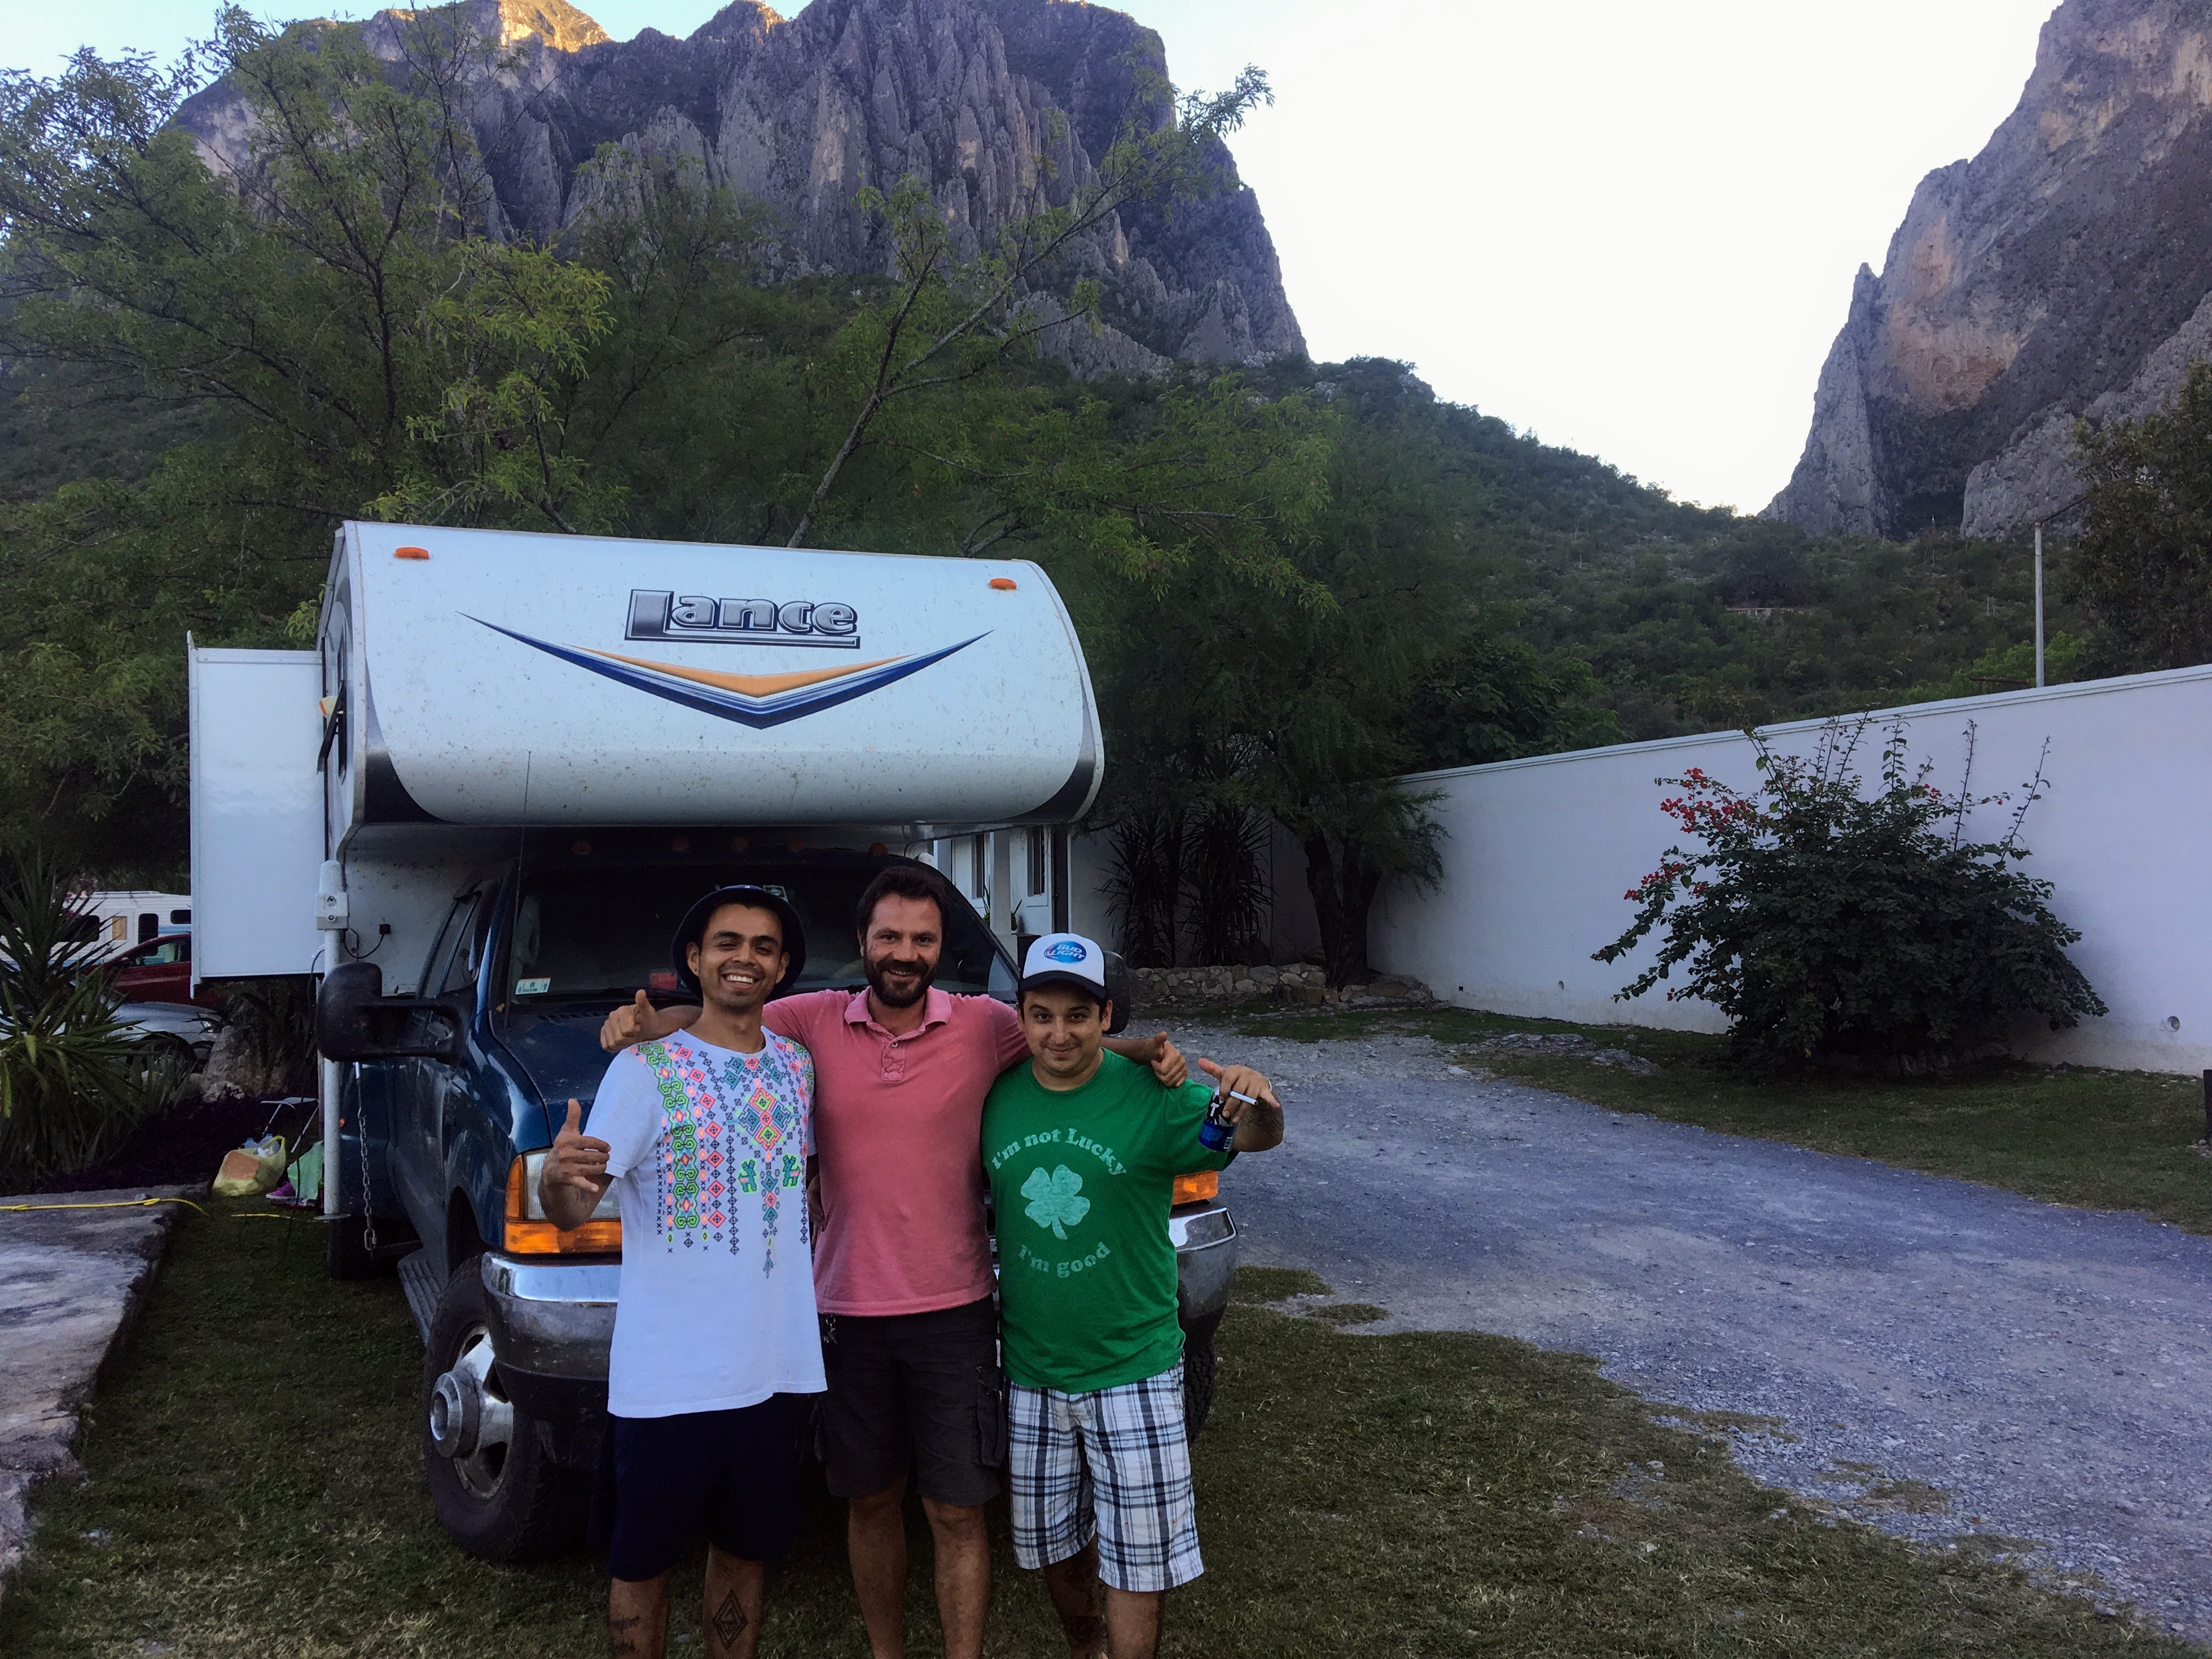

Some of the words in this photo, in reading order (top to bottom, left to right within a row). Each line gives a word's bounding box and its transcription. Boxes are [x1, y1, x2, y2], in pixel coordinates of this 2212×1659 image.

[624, 589, 860, 649] Lance
[1051, 950, 1085, 959] LIGHT
[1057, 944, 1082, 953] BUD
[992, 1141, 1020, 1169] I'm
[1024, 1128, 1061, 1147] not
[1065, 1128, 1127, 1175] Lucky
[1018, 1244, 1049, 1272] I'm
[1057, 1242, 1110, 1278] good
